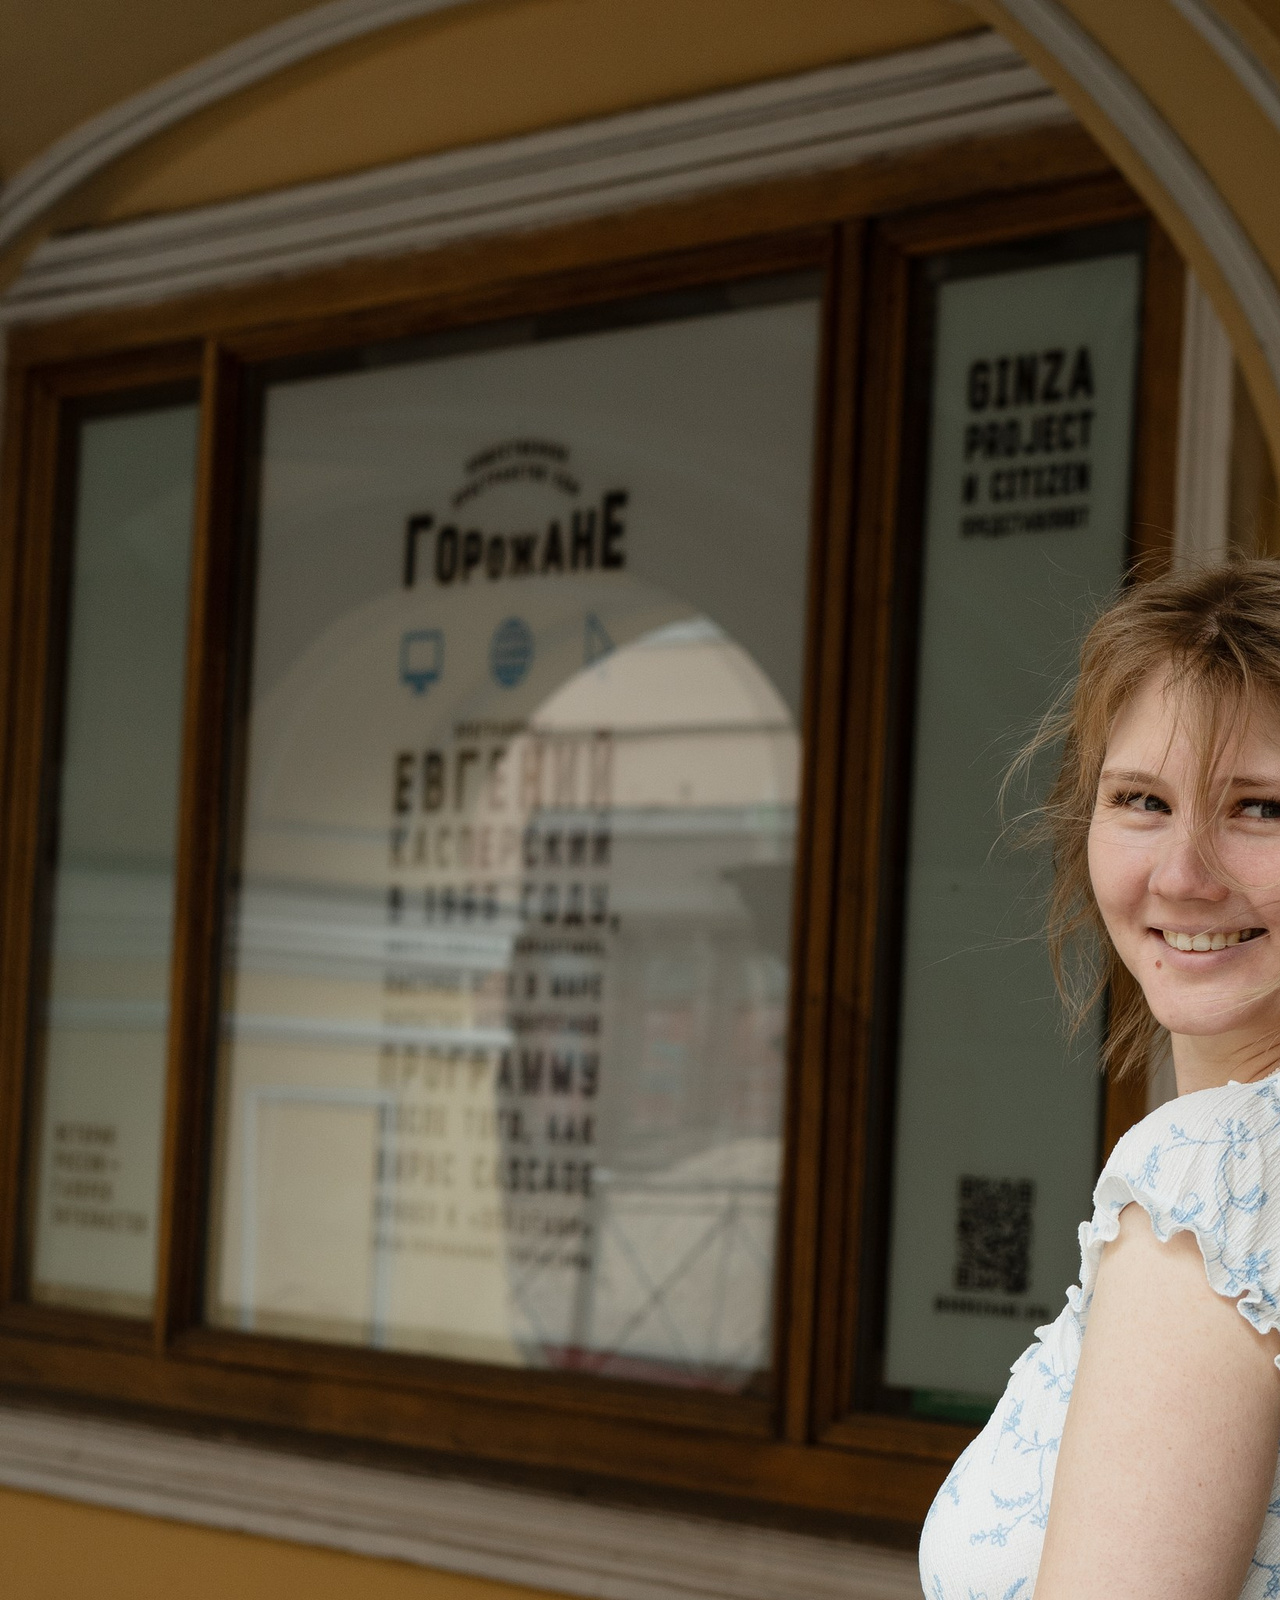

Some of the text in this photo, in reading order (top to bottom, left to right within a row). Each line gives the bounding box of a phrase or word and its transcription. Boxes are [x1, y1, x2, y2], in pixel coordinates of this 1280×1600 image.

[967, 346, 1094, 414] GINZA
[964, 409, 1096, 463] PROJECT
[990, 461, 1092, 503] CITIZEN
[402, 488, 630, 590] ГОРОЖАНЕ
